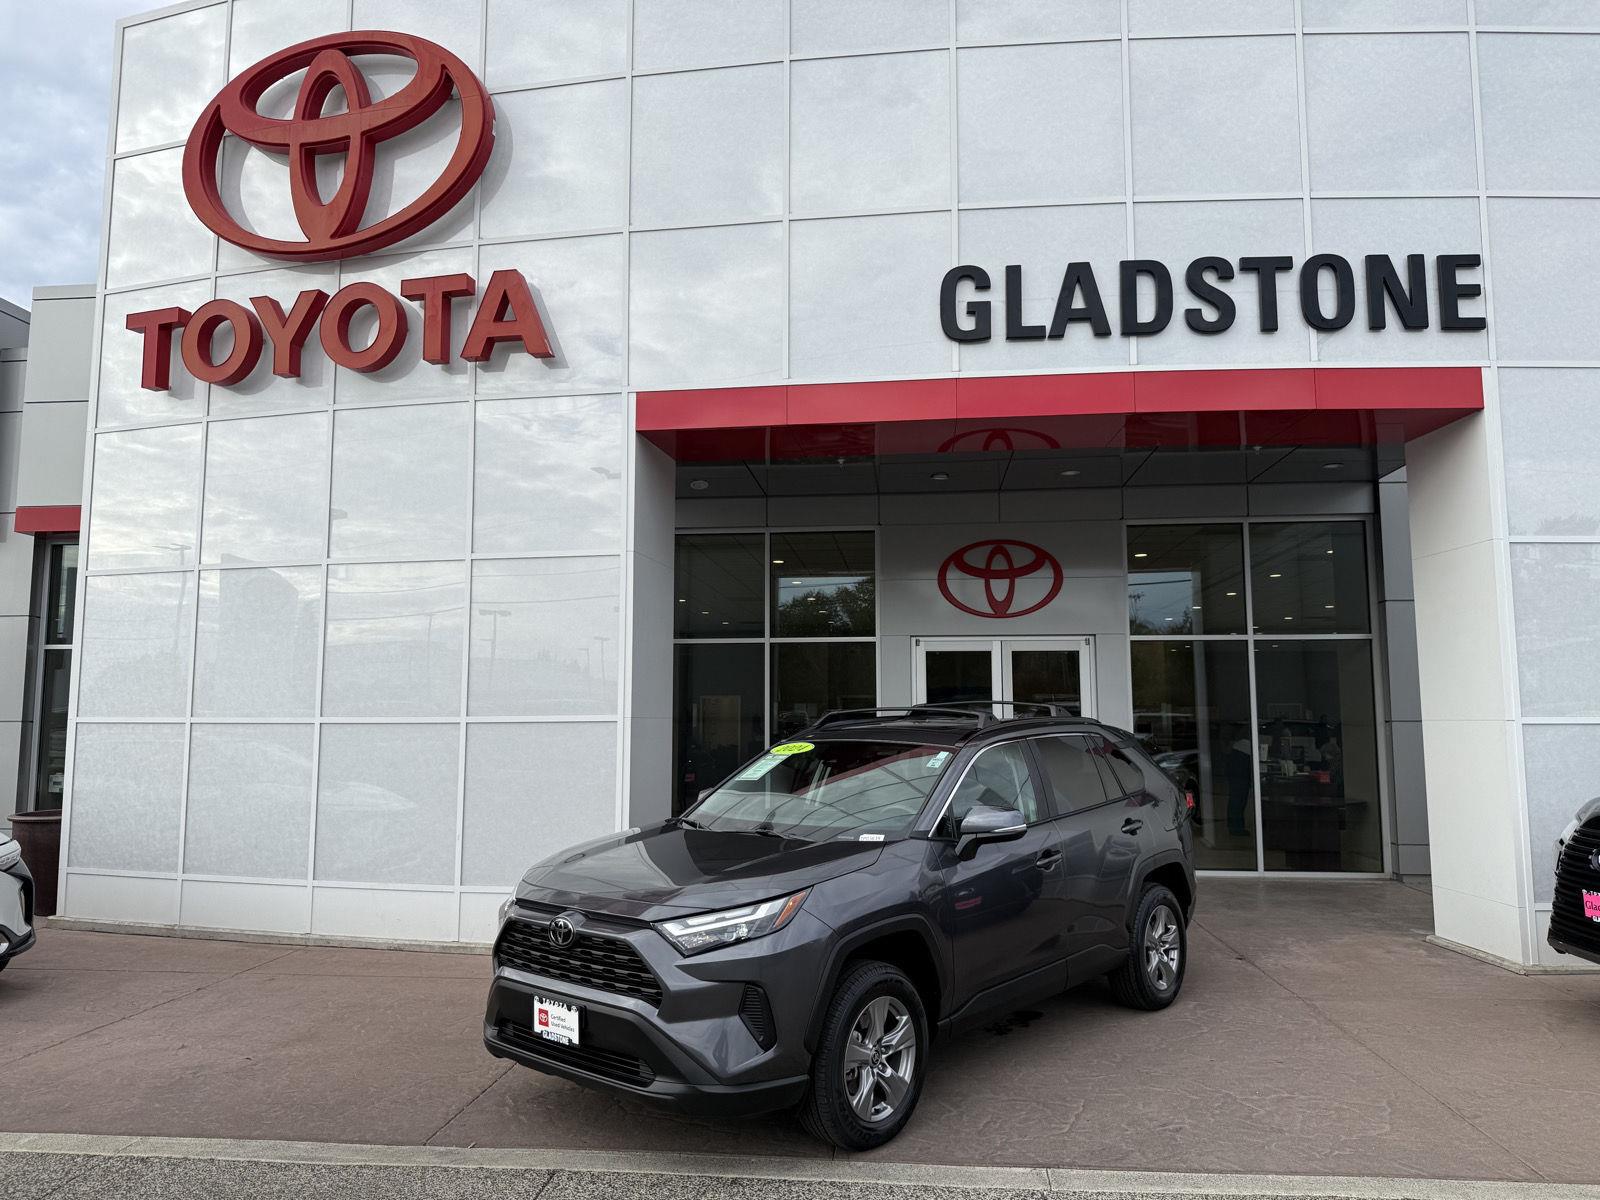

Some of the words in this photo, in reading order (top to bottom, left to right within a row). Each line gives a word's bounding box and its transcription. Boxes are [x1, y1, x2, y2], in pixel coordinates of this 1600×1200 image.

[126, 269, 555, 391] TOYOTA
[940, 254, 1487, 342] GLADSTONE
[542, 997, 568, 1010] TOYOTA
